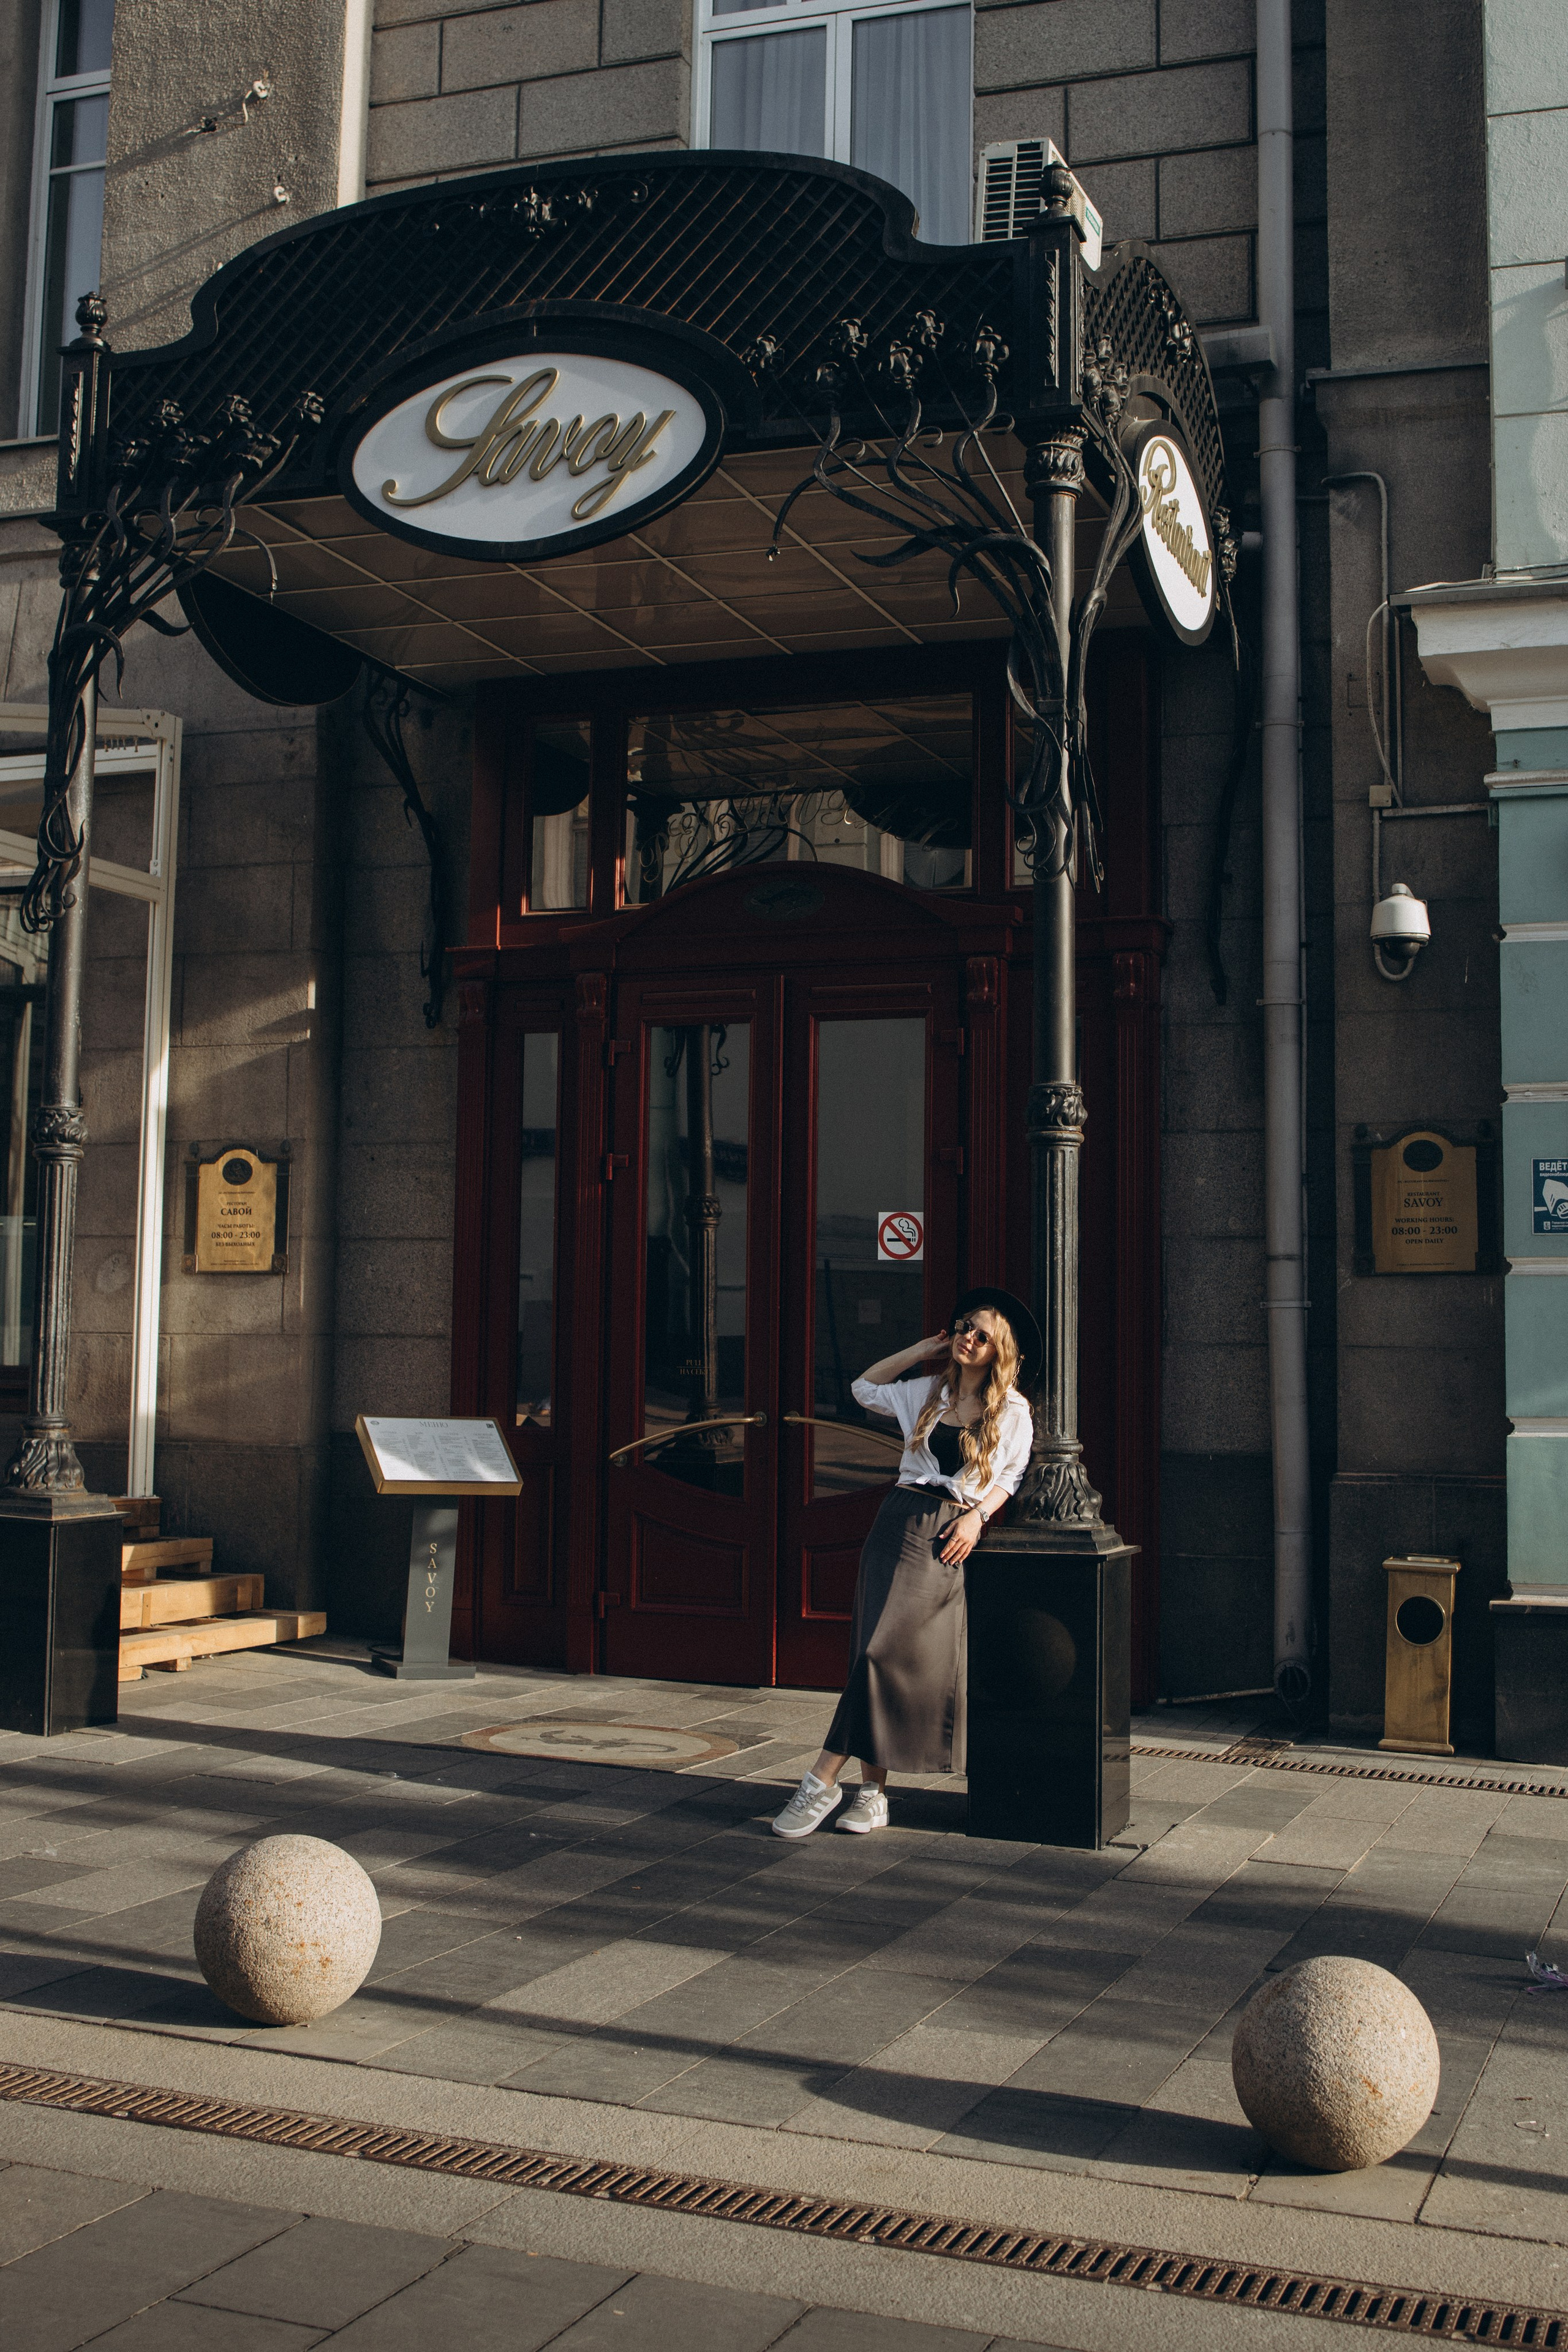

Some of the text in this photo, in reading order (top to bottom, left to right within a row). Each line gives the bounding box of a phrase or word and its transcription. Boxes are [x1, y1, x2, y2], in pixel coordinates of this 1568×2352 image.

[381, 367, 677, 520] Savoy
[1139, 439, 1213, 598] Restaurant
[1539, 1160, 1568, 1172] ВЕДЁТ
[1403, 1197, 1443, 1208] SAVOY
[221, 1205, 252, 1216] САВОЙ
[1392, 1226, 1420, 1235] 08:00
[1429, 1226, 1458, 1235] 23:00
[424, 1543, 437, 1613] SAVOY
